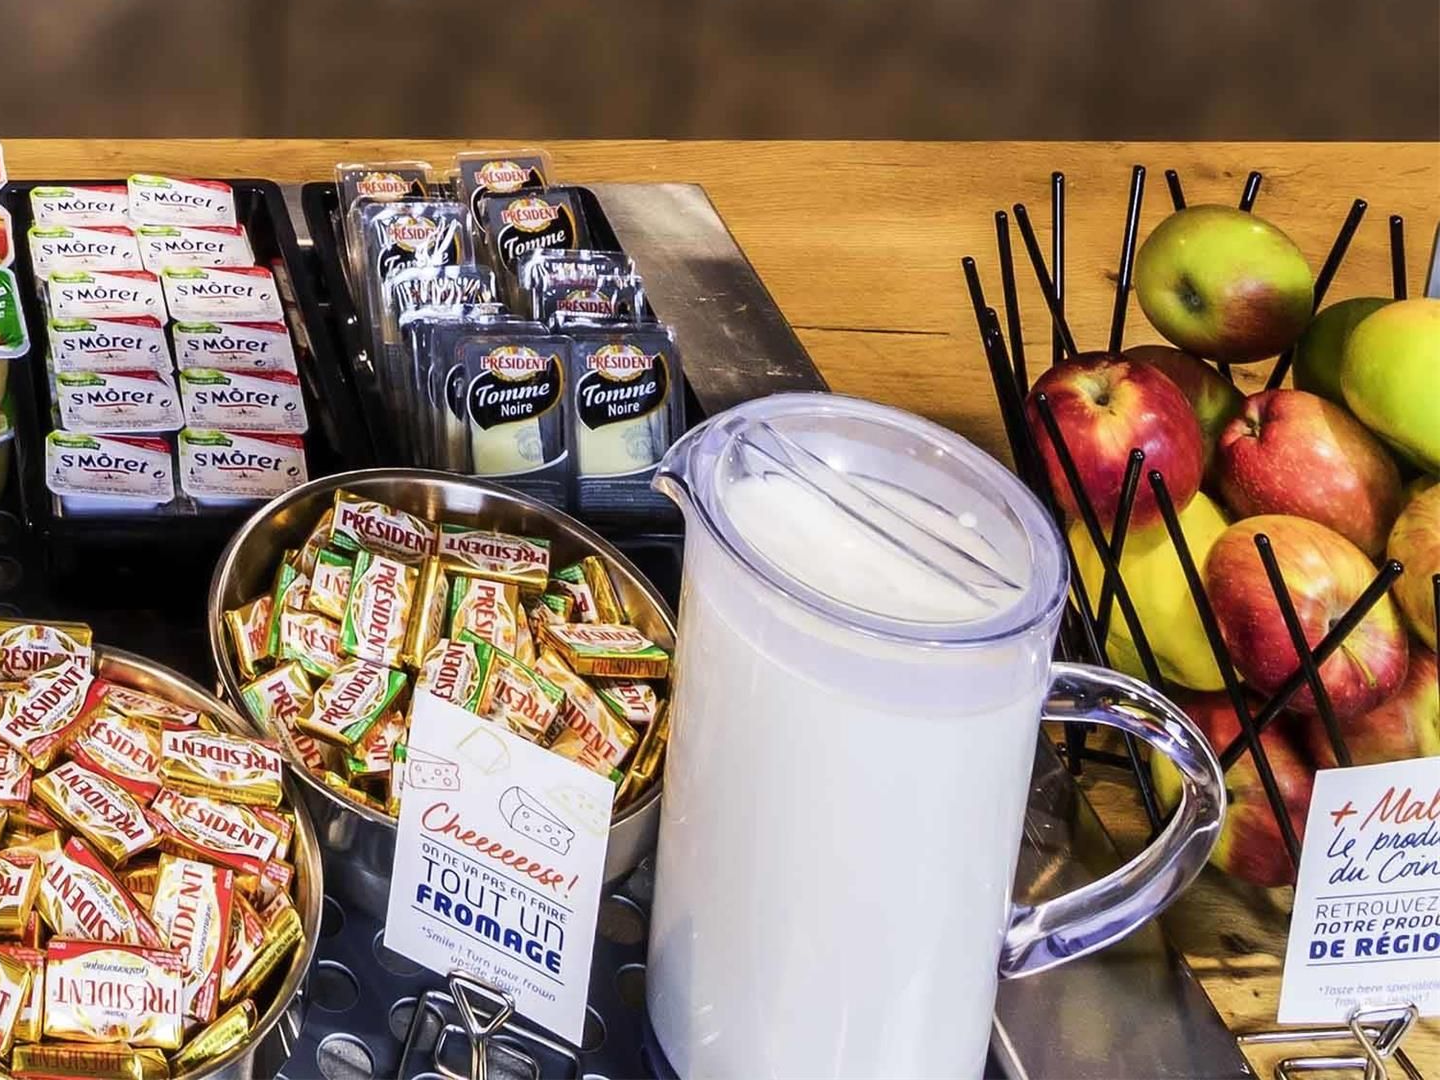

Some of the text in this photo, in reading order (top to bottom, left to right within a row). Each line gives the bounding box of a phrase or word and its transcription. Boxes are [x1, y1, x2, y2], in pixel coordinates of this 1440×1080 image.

[358, 181, 413, 194] PRÉSIDENT
[475, 167, 530, 185] PRÉSIDENT
[501, 204, 559, 224] PRÉSIDENT
[504, 229, 567, 258] Tomme
[481, 355, 548, 370] PRÉSIDENT
[587, 354, 654, 370] PRÉSIDENT
[475, 381, 551, 407] Tomme
[582, 380, 657, 407] Tomme
[500, 402, 534, 418] Noire
[607, 400, 640, 417] Noire
[342, 508, 438, 556] PRÉSIDENT
[445, 538, 548, 565] PRÉSIDENT
[5, 666, 85, 737] PRÉSIDENT
[169, 736, 280, 774] PRÉSIDENT
[54, 767, 145, 841] PRÉSIDENT
[160, 788, 270, 850] PRÉSIDENT
[1326, 826, 1357, 860] Le
[1327, 850, 1440, 886] du Coin
[443, 850, 459, 868] NE
[462, 863, 478, 878] VA
[482, 872, 506, 892] PAS
[510, 889, 527, 903] EN
[530, 897, 568, 925] FAIRE
[422, 855, 565, 952] TOUT UN
[1315, 895, 1440, 920] RETROUVEZ
[416, 883, 562, 974] FROMAGE
[1312, 917, 1379, 936] NOTRE
[1308, 939, 1346, 961] DE
[450, 954, 522, 997] upside down
[466, 948, 491, 968] Turn
[493, 963, 520, 982] your
[522, 976, 557, 1002] frown
[56, 977, 178, 1016] PRÉSIDENT
